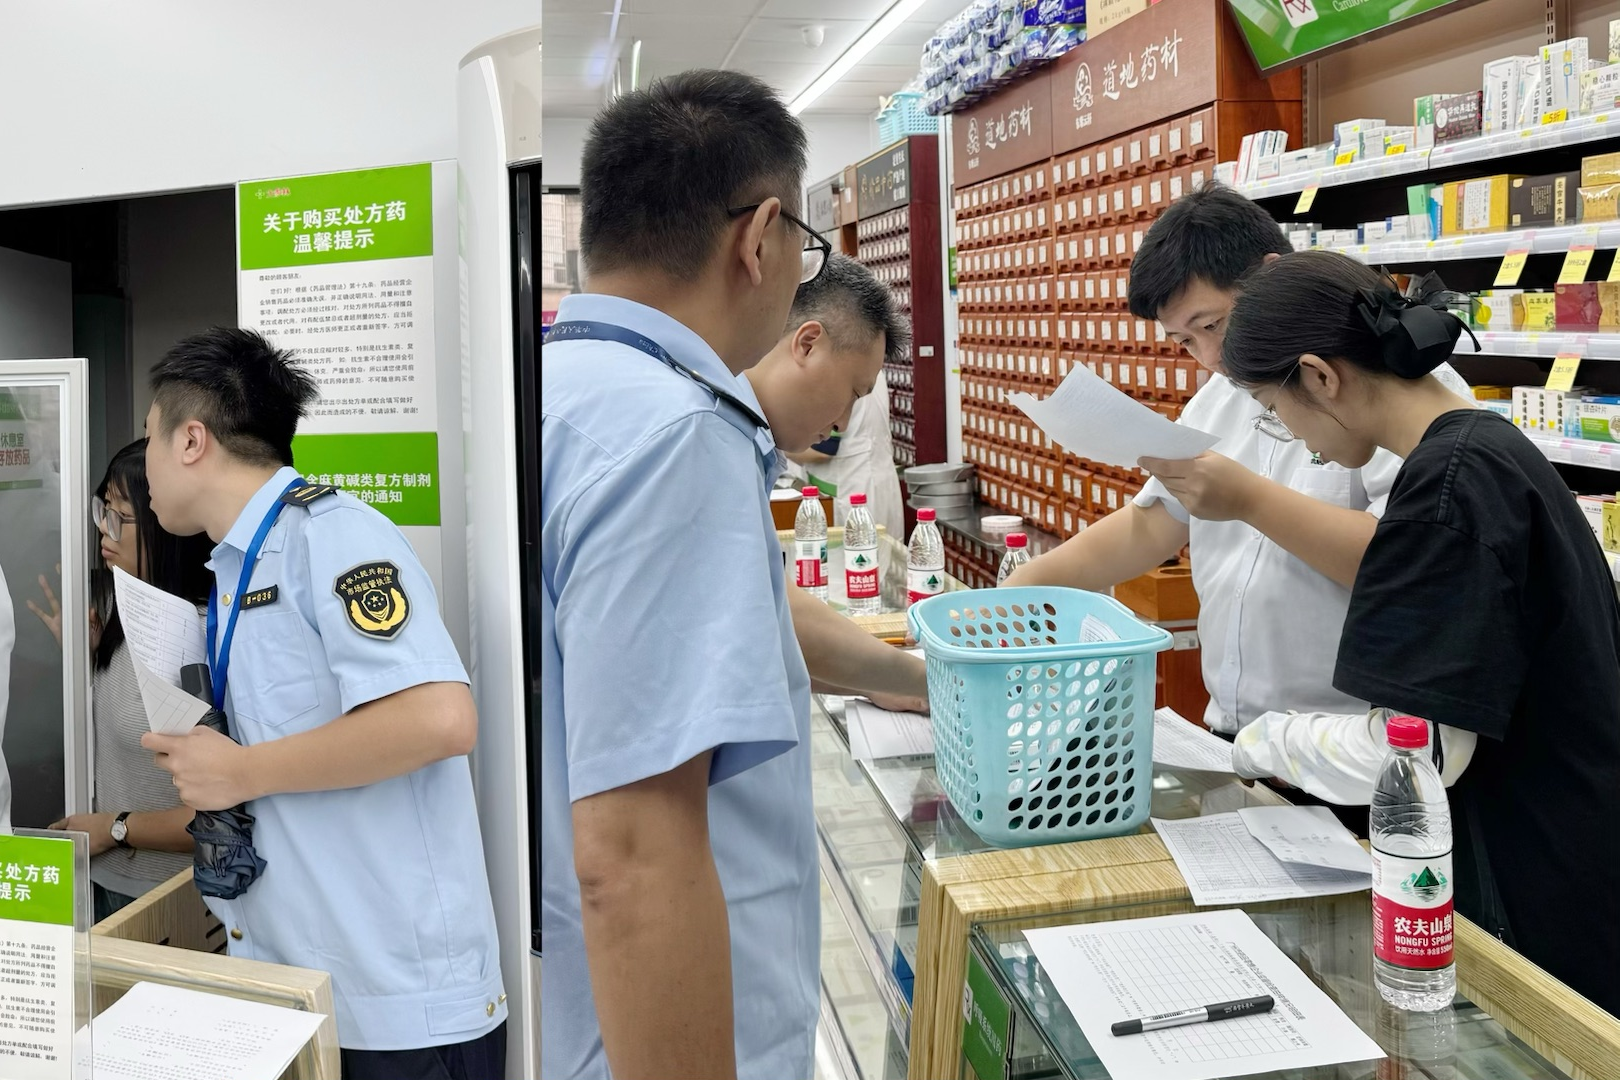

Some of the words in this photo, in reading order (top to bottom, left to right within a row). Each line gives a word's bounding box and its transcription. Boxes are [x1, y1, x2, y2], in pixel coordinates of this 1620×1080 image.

[1102, 28, 1183, 101] 道地药材
[984, 98, 1034, 150] 道地药材
[262, 200, 407, 234] 关于购买处方药
[292, 227, 375, 253] 温馨提示
[339, 566, 394, 591] 中华人民共和国
[346, 576, 394, 596] 市场监管执法
[1394, 916, 1453, 935] 农夫山泉
[1394, 934, 1429, 947] NONGFU
